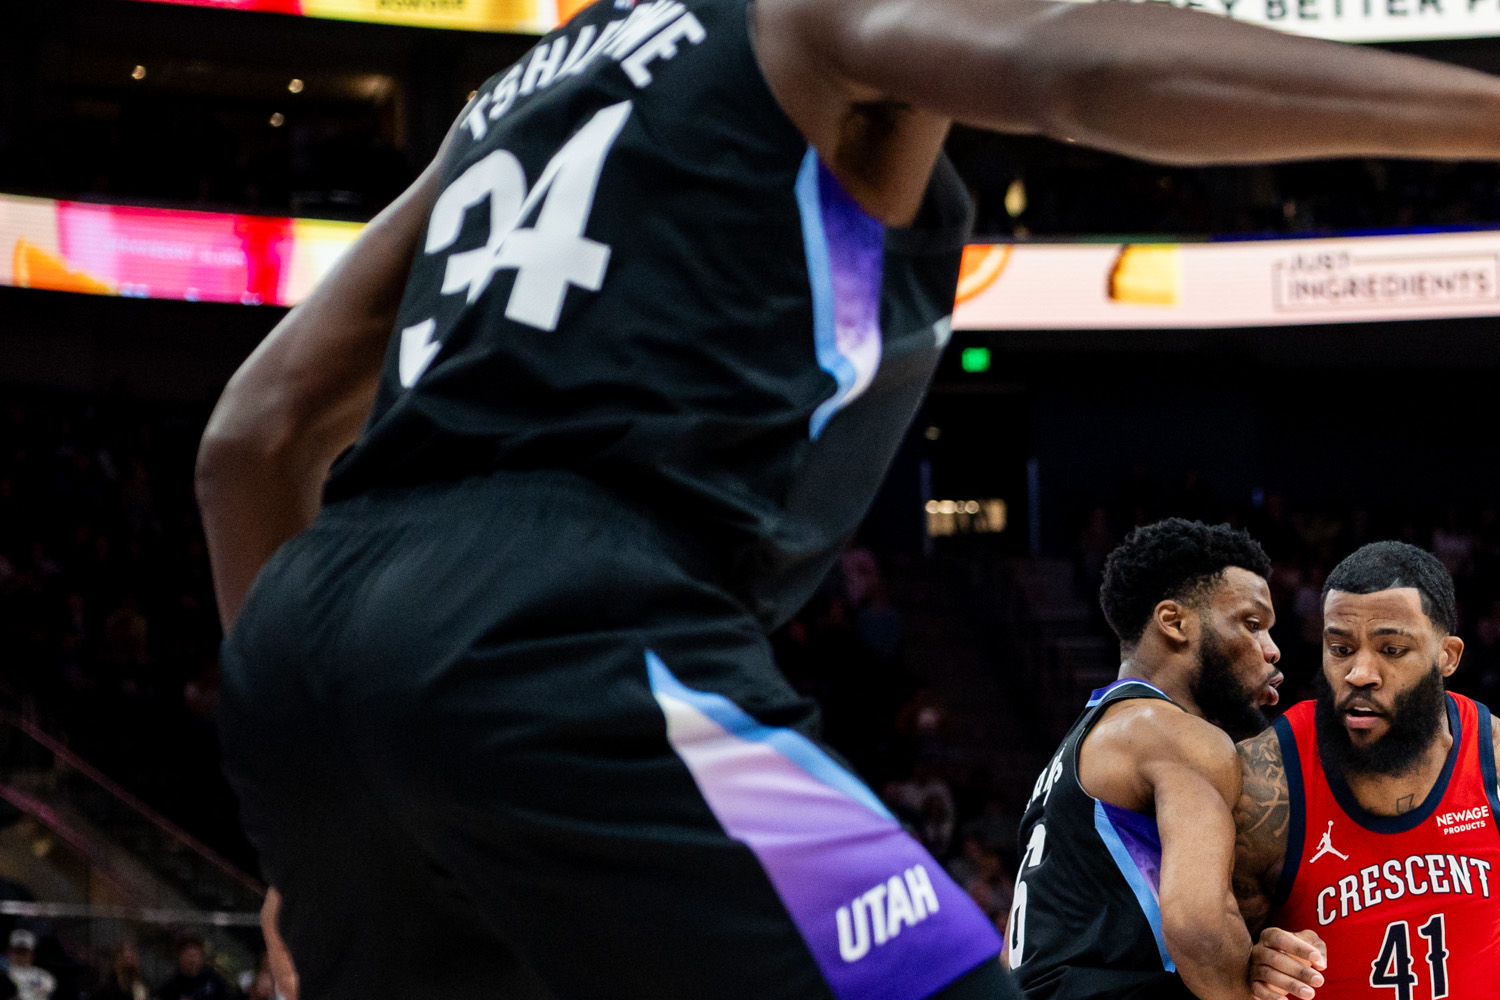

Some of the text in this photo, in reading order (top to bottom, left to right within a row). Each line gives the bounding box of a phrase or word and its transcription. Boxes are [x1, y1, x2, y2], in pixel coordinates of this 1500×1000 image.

[400, 100, 633, 389] 34
[1290, 251, 1350, 271] JUST
[1288, 270, 1492, 300] INGREDIENTS
[1436, 805, 1489, 827] NEWAGE
[1443, 820, 1486, 835] PRODUCTS
[1316, 854, 1492, 926] CRESCENT
[835, 864, 940, 963] UTAH
